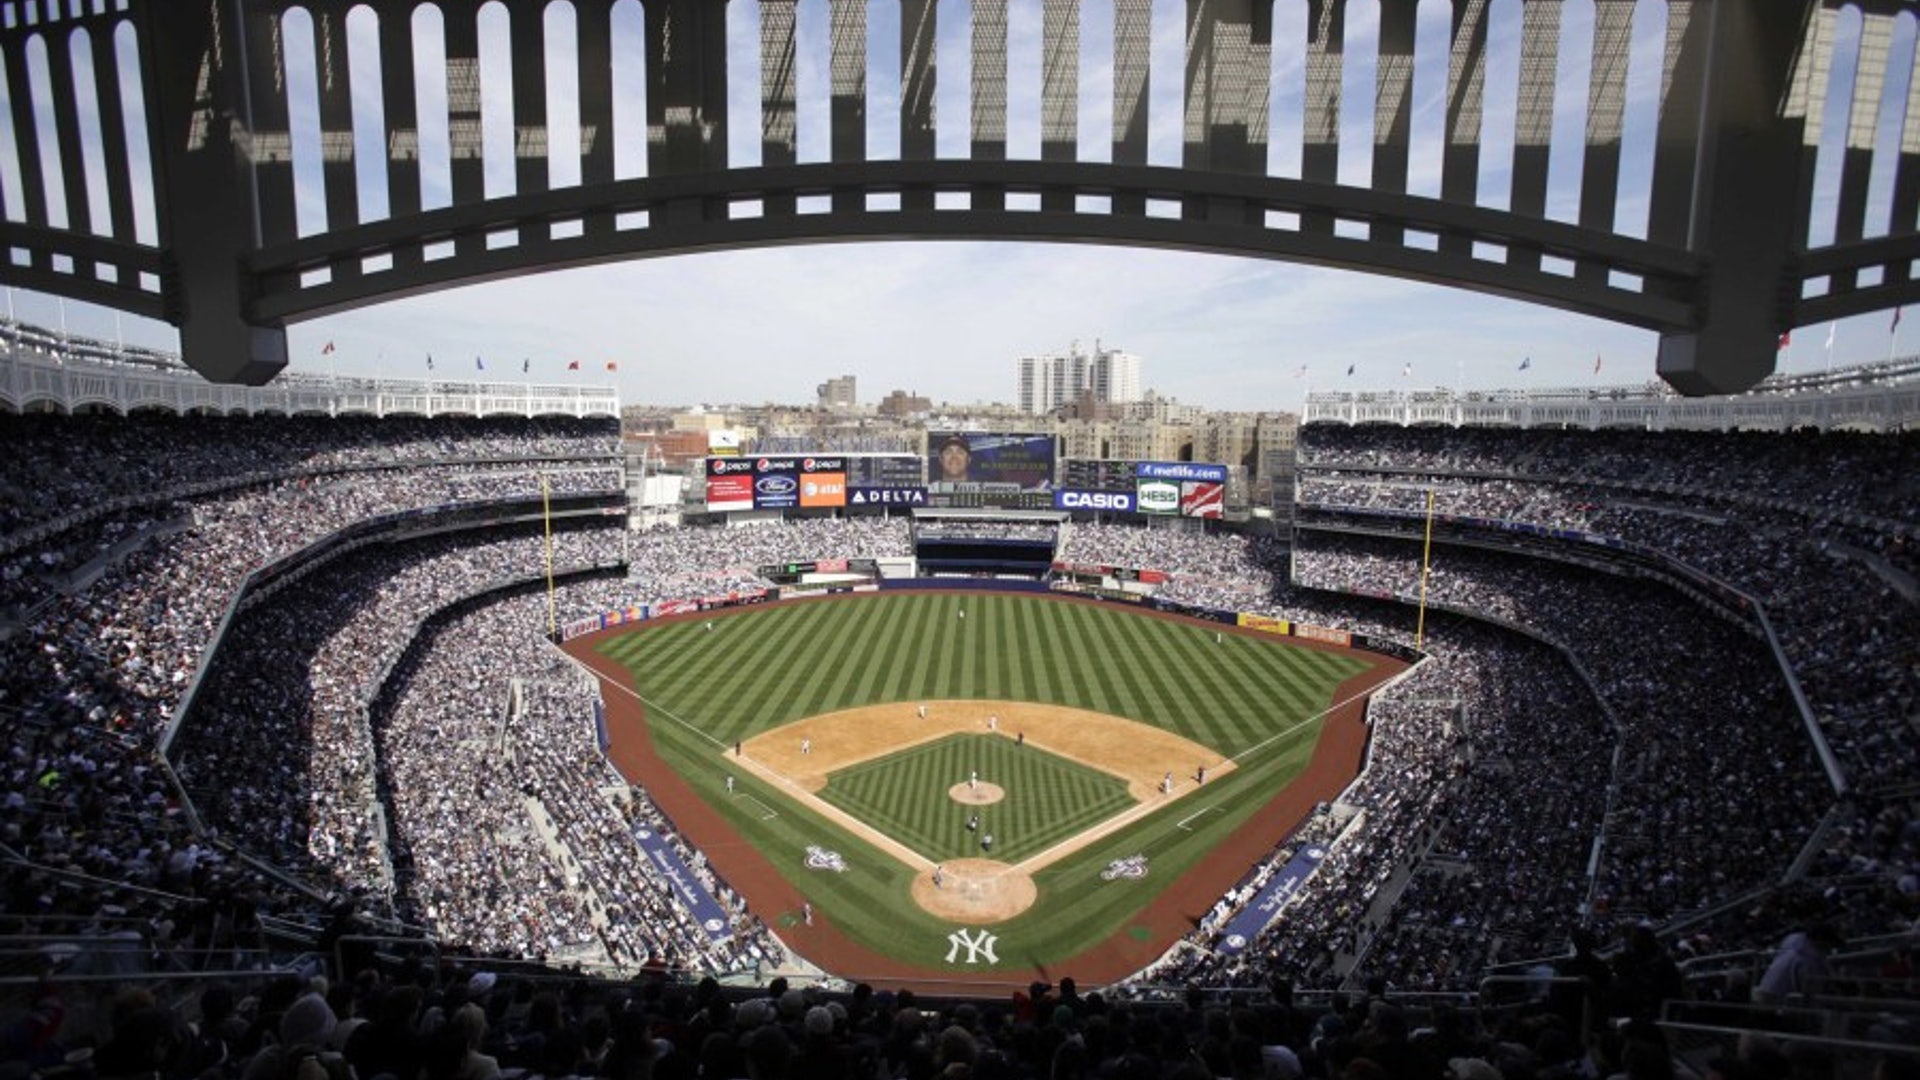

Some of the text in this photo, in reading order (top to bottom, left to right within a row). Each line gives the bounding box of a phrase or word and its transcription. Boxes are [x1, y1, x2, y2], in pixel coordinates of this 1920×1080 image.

[816, 460, 841, 470] pepsi
[1153, 465, 1221, 479] metlife.com
[819, 482, 842, 495] at&t
[869, 490, 923, 502] DELTA
[1062, 492, 1130, 509] CASIO
[1140, 491, 1176, 502] HESS
[944, 928, 1000, 965] NY
